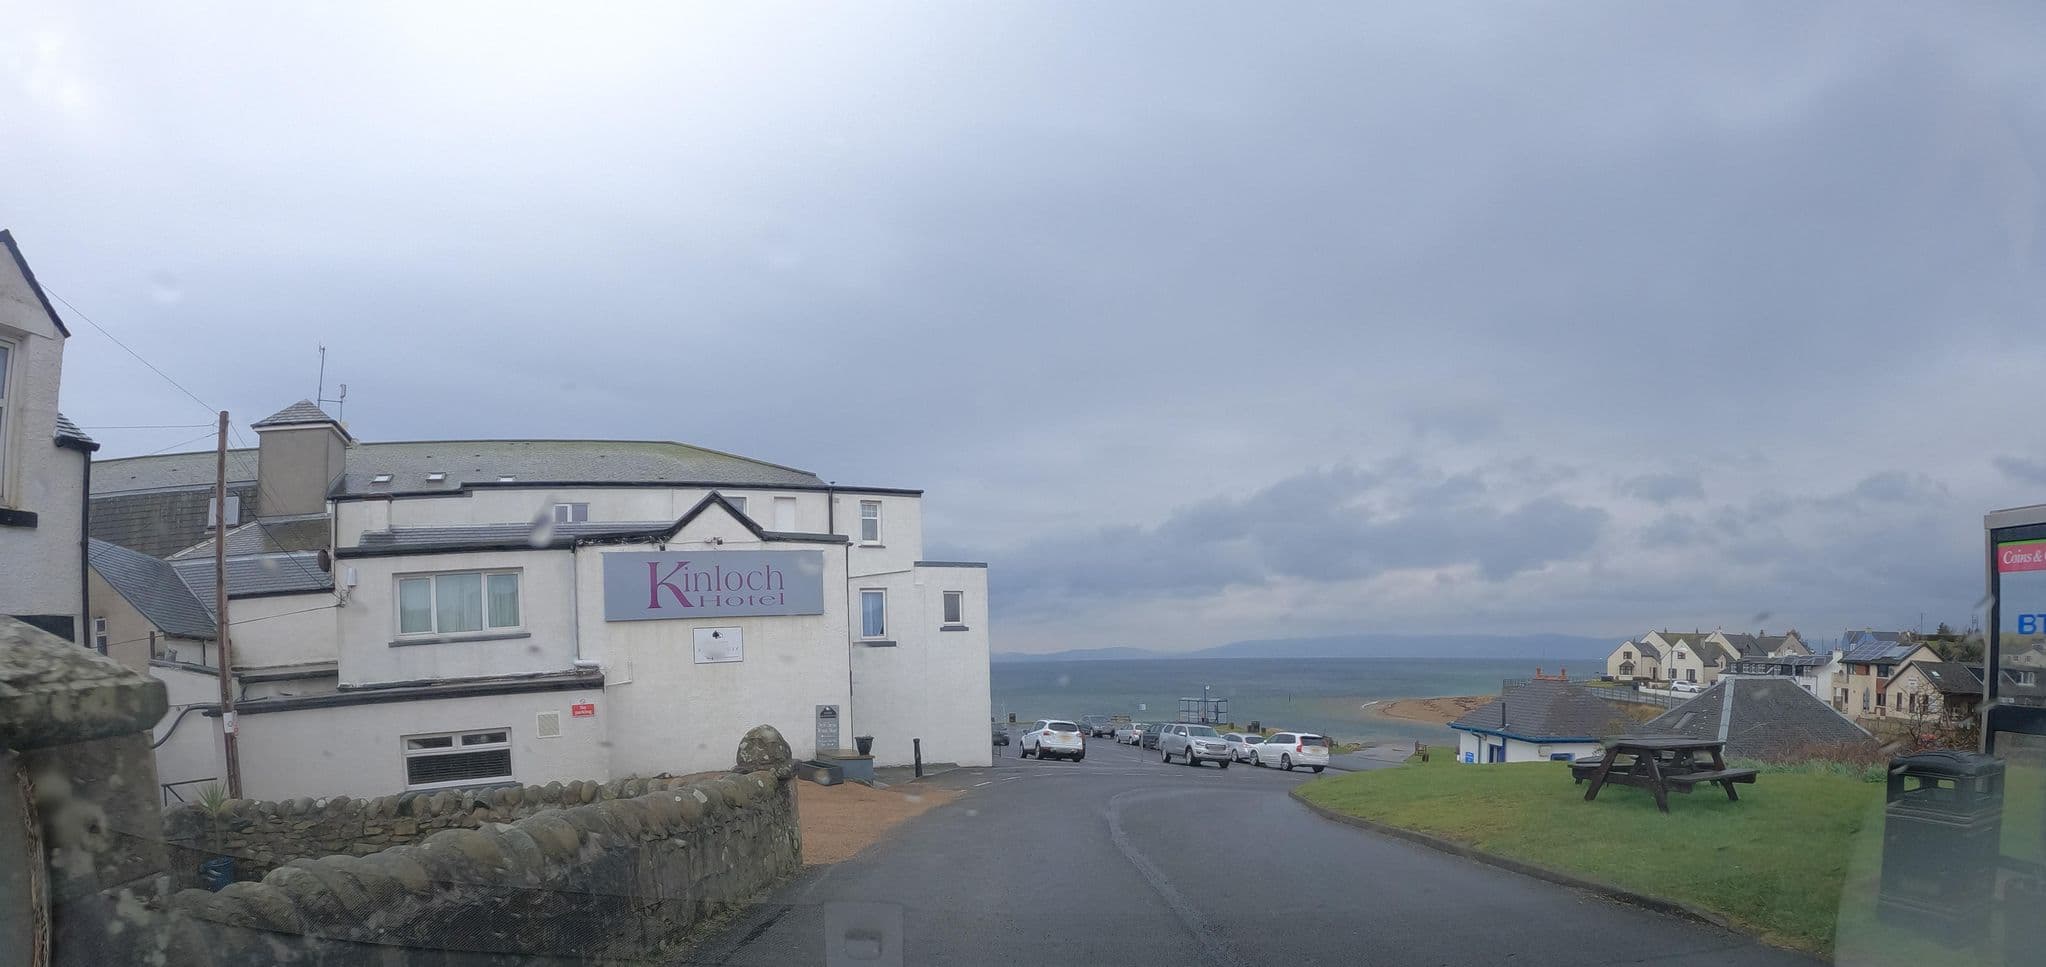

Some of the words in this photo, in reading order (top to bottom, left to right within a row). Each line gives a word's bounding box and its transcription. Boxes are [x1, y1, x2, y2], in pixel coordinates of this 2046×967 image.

[2003, 549, 2032, 564] Coins
[2033, 551, 2042, 562] &
[647, 561, 784, 609] Kinloch
[700, 593, 785, 607] Hotel
